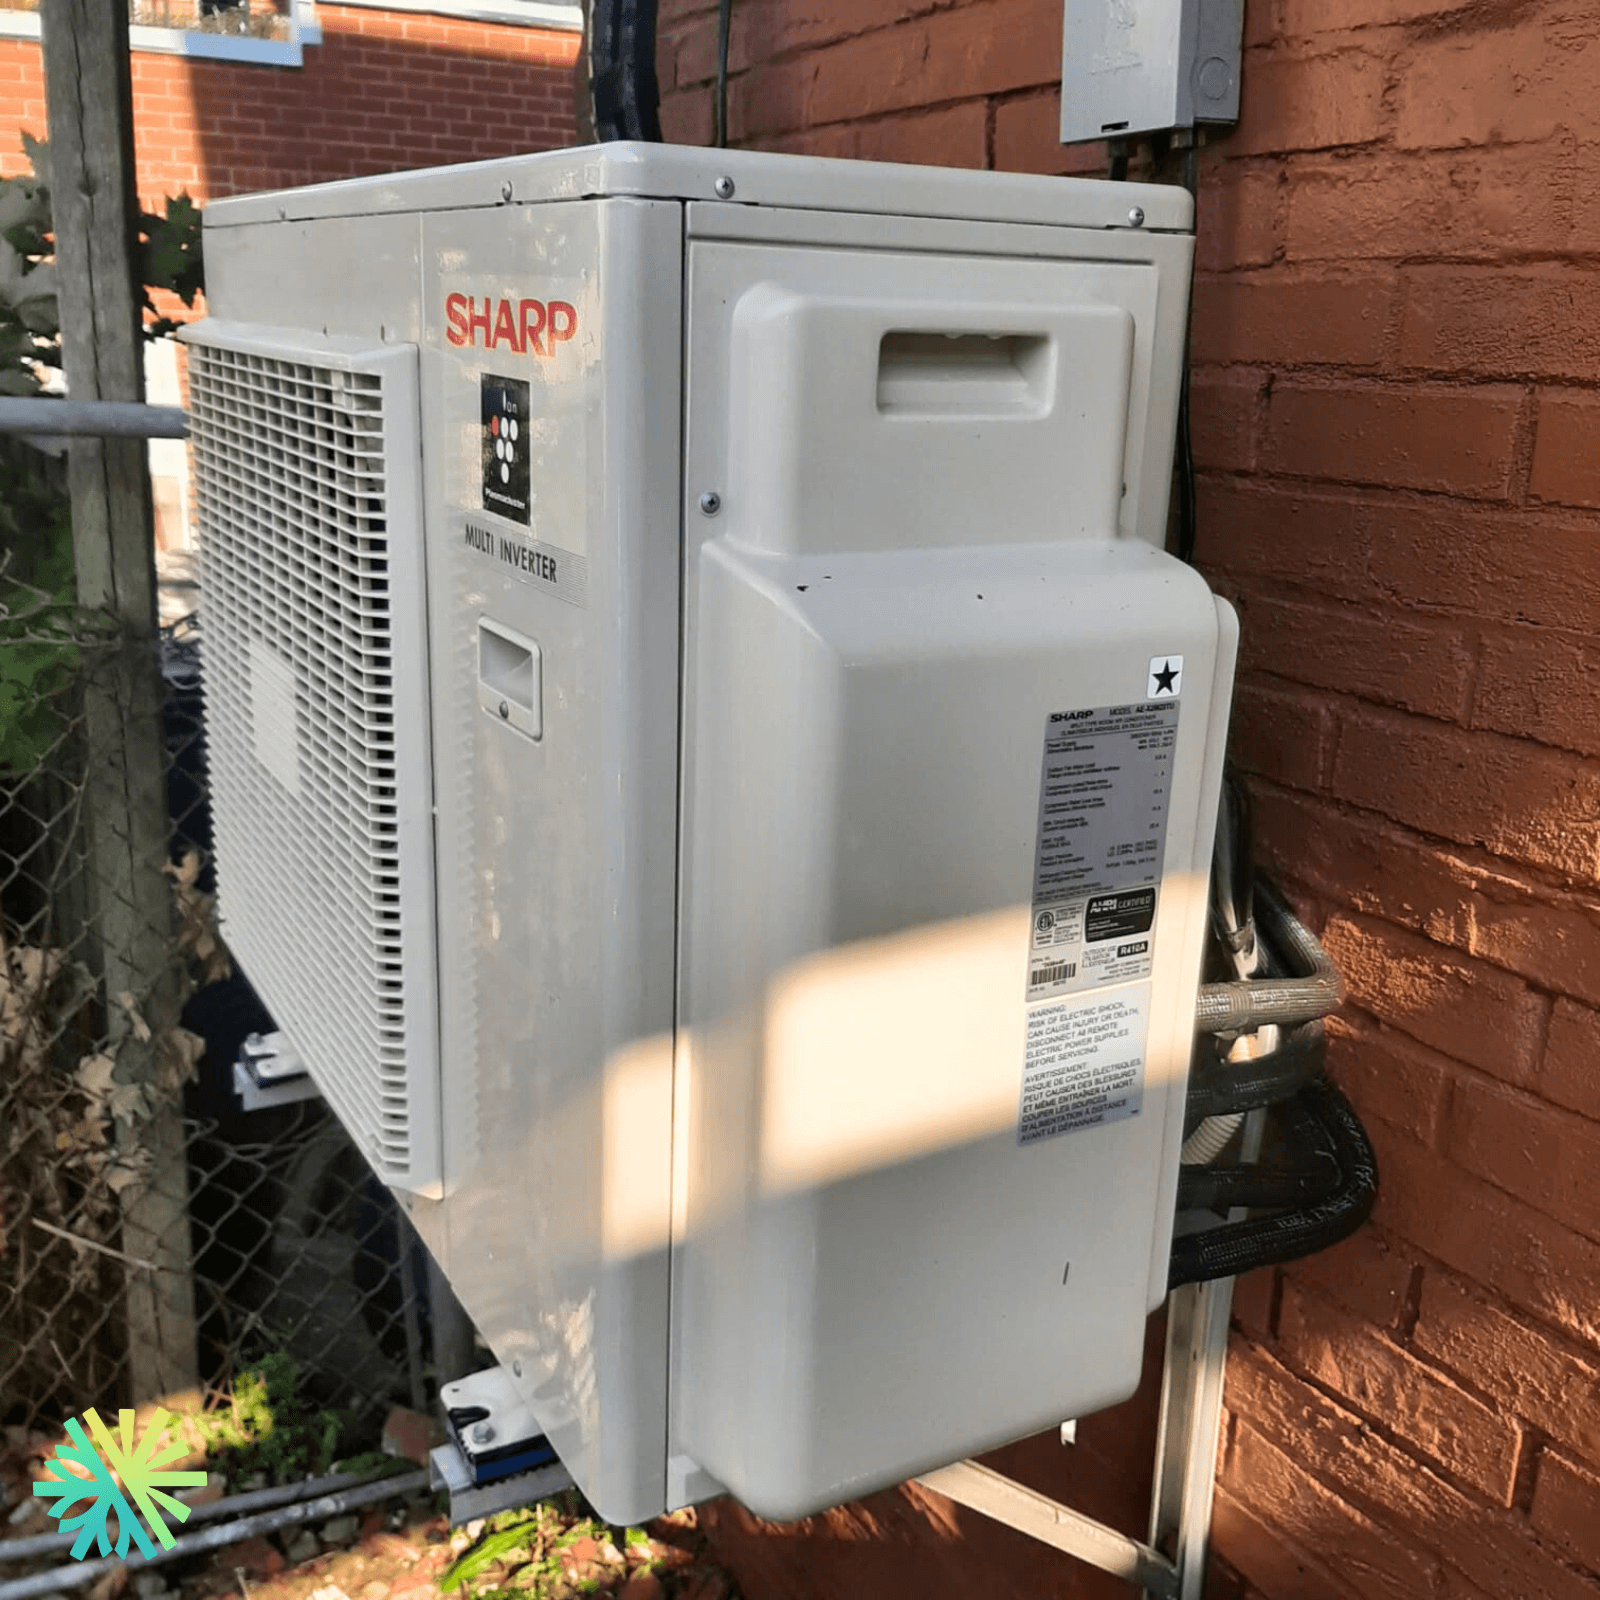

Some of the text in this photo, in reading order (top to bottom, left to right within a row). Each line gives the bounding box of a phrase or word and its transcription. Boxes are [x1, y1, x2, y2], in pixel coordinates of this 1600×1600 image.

[446, 292, 578, 358] SHARP
[465, 523, 557, 583] MULTI INVERTER
[1050, 710, 1093, 723] SHARP
[1027, 1029, 1043, 1039] CAN
[1045, 1023, 1070, 1035] CAUSE
[1073, 1017, 1098, 1028] INJURY
[1100, 1013, 1111, 1022] OR
[1028, 1019, 1045, 1028] RISK
[1047, 1015, 1058, 1024] OF
[1060, 1007, 1096, 1021] ELECTRIC
[1026, 1028, 1129, 1059] ELECTRIC POWER SUPPLIES
[1027, 1031, 1075, 1048] DISCONNECT
[1088, 1022, 1118, 1034] REMOTE
[1026, 1055, 1056, 1069] BEFORE
[1023, 1068, 1136, 1102] PEUT CAUSER DES BLESSURES
[1024, 1081, 1051, 1093] RISQUE
[1053, 1077, 1063, 1085] DE
[1065, 1071, 1090, 1082] CHOCS
[1023, 1104, 1033, 1112] ET
[1102, 1083, 1111, 1092] LA
